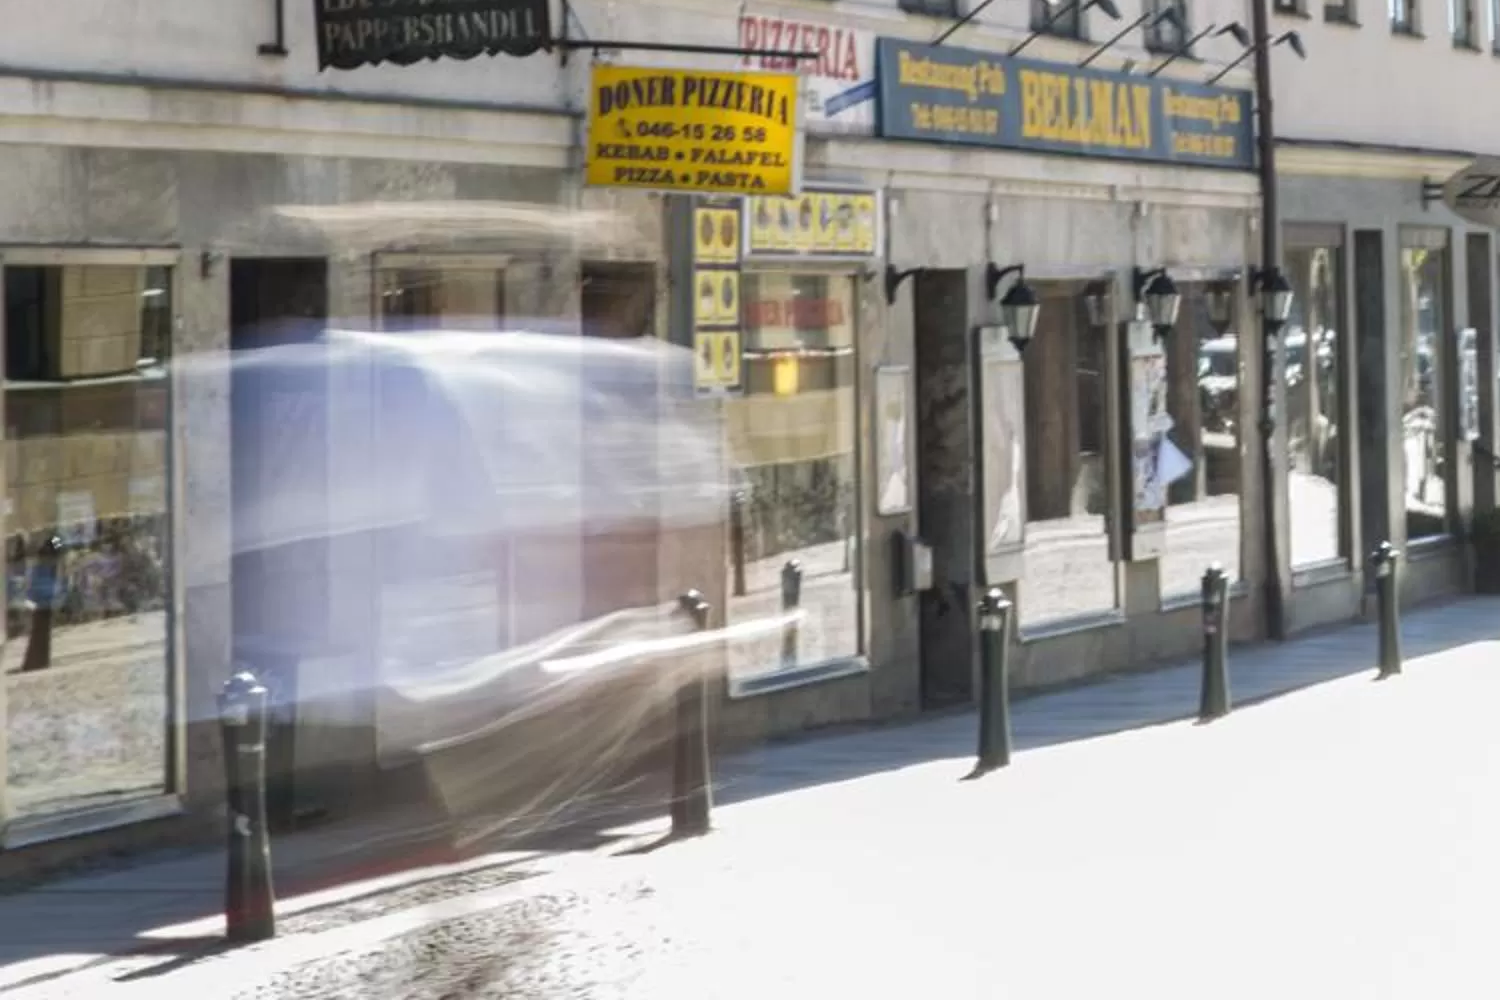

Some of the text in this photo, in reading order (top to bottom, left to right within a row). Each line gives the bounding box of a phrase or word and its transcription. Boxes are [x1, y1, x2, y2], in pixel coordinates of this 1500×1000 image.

[323, 7, 540, 52] PAPPRSHANDEL
[743, 17, 860, 81] PIZZERIA
[683, 76, 788, 125] PIZZERIA
[1019, 69, 1151, 149] BELLMAN
[596, 143, 785, 167] KEBAB FALAFEL
[711, 125, 735, 141] 26
[743, 126, 766, 142] 58
[614, 167, 765, 189] PIZZA PASTA
